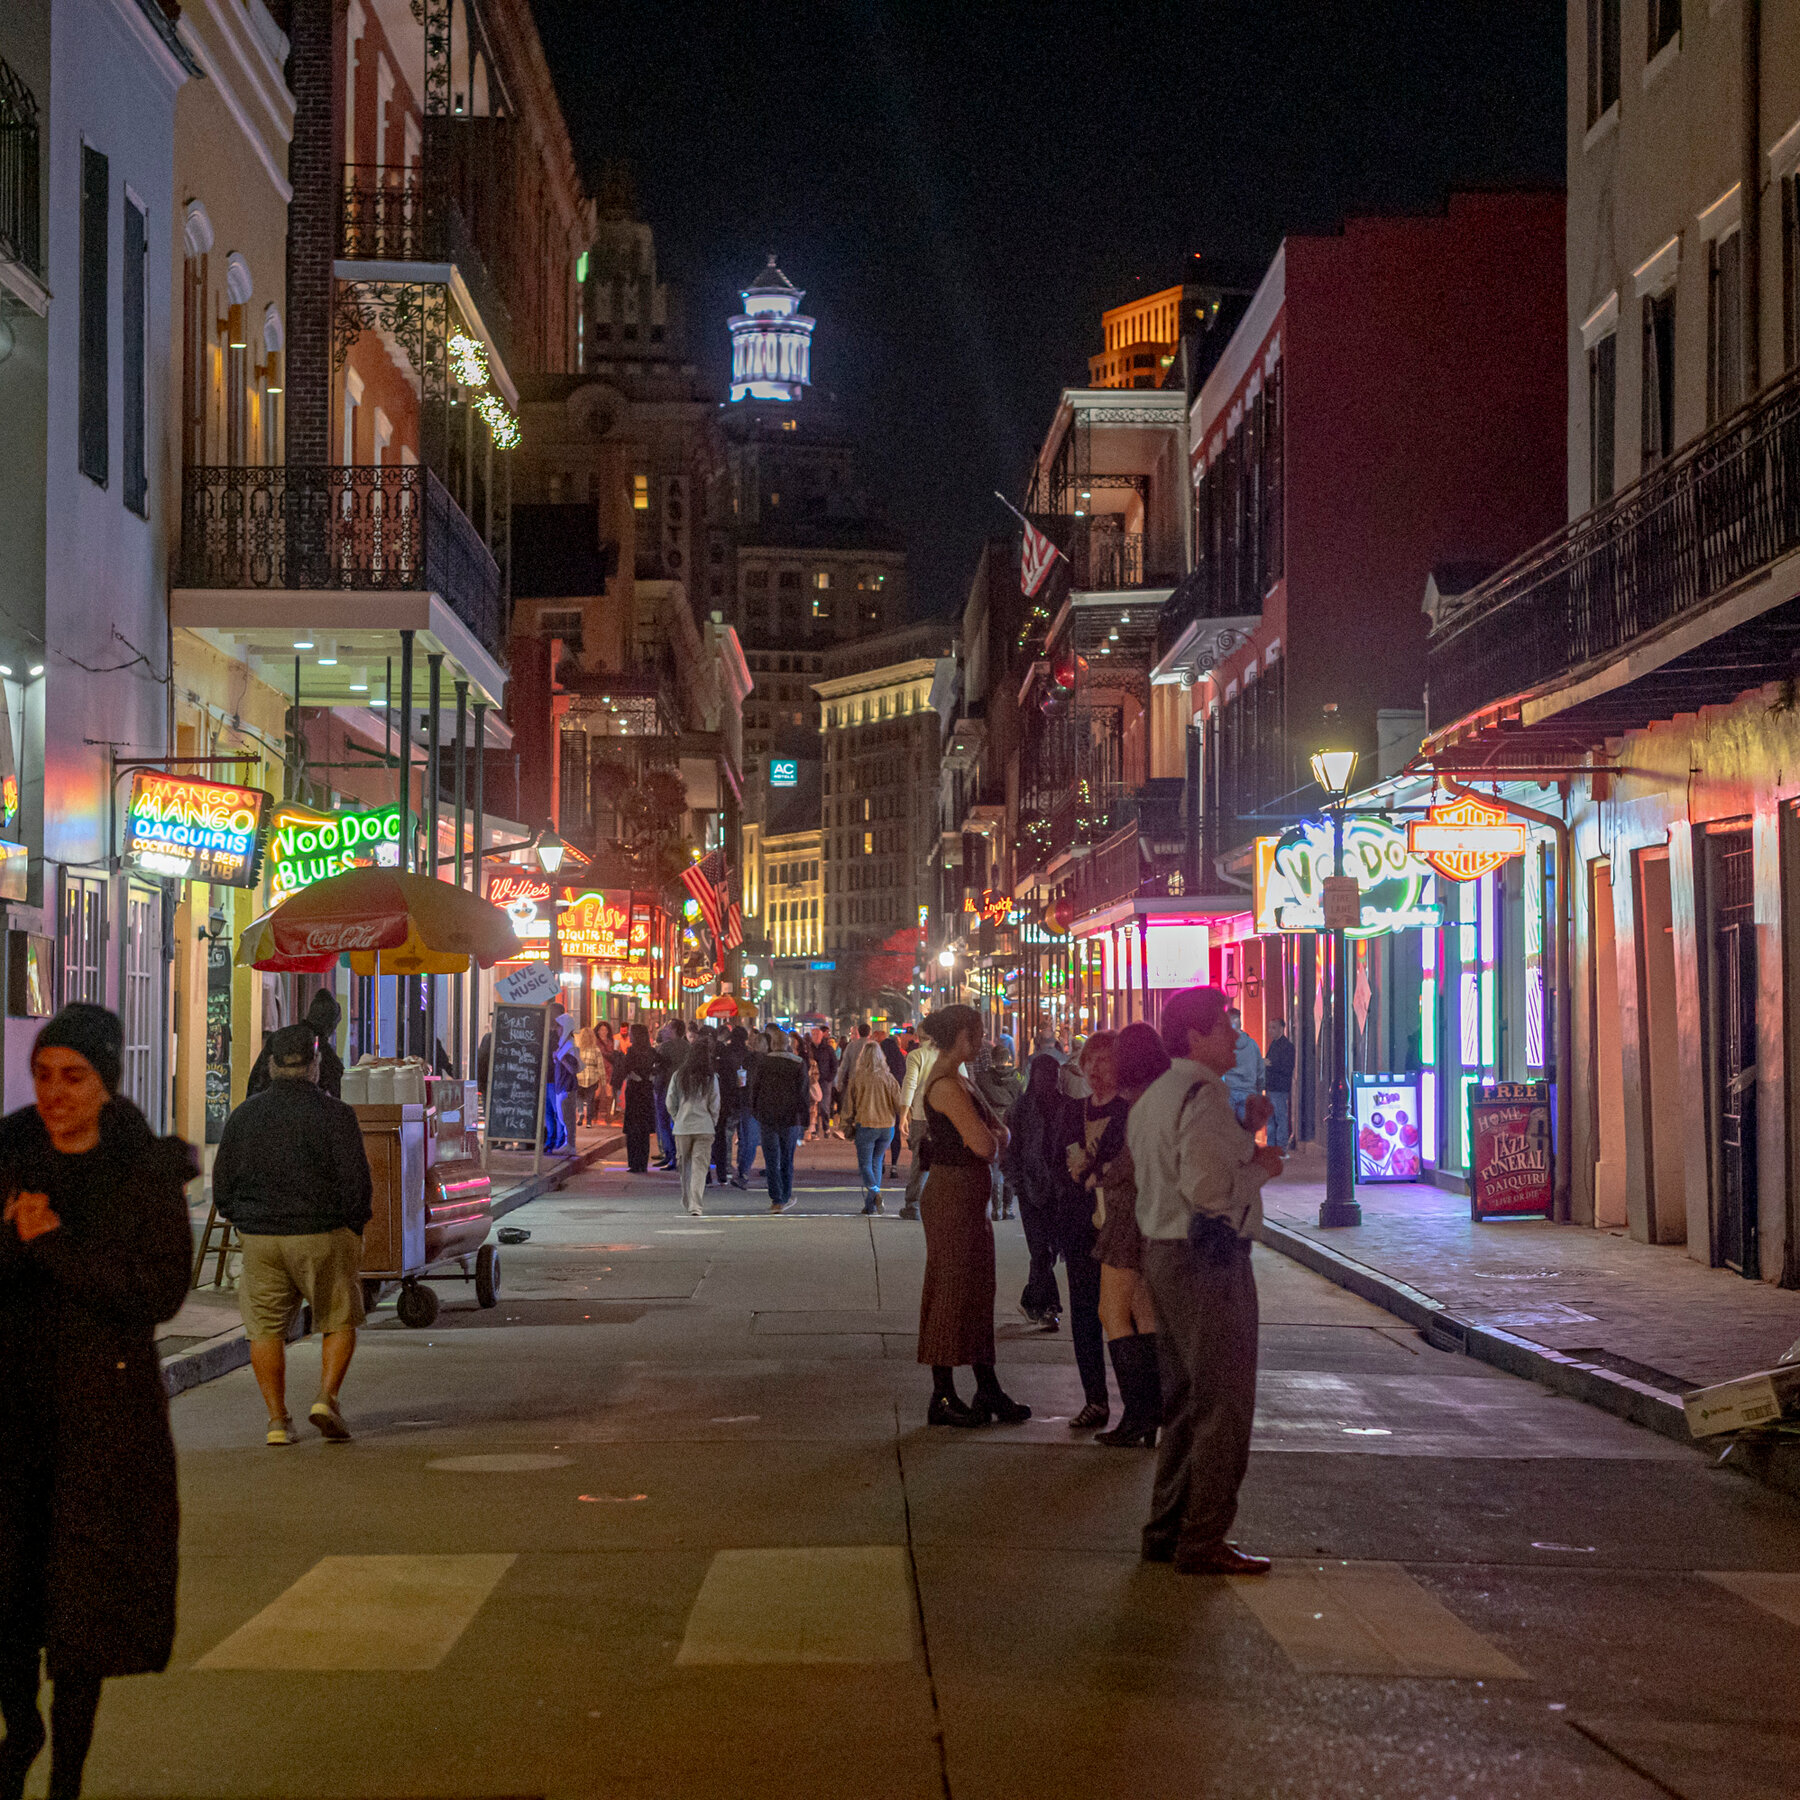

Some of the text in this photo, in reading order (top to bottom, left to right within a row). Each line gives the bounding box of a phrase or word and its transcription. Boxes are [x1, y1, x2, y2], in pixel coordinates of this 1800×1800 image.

[774, 763, 794, 774] AC
[153, 782, 239, 806] MANGO
[134, 792, 255, 835] MANGO
[135, 819, 248, 853] DAIQUIRIS
[132, 837, 245, 867] COCKTAILS & BEER
[200, 861, 234, 880] PUB
[278, 849, 357, 889] BLUES
[491, 878, 550, 901] Willie's
[584, 903, 626, 929] EASY
[583, 943, 597, 953] THE
[507, 965, 537, 986] LIVE
[509, 973, 548, 1001] MUSIC
[1483, 1085, 1537, 1098] FREE
[1491, 1133, 1530, 1164] JAZZ
[1481, 1150, 1545, 1181] FUNERAL
[1485, 1172, 1545, 1195] DAIQUIRI
